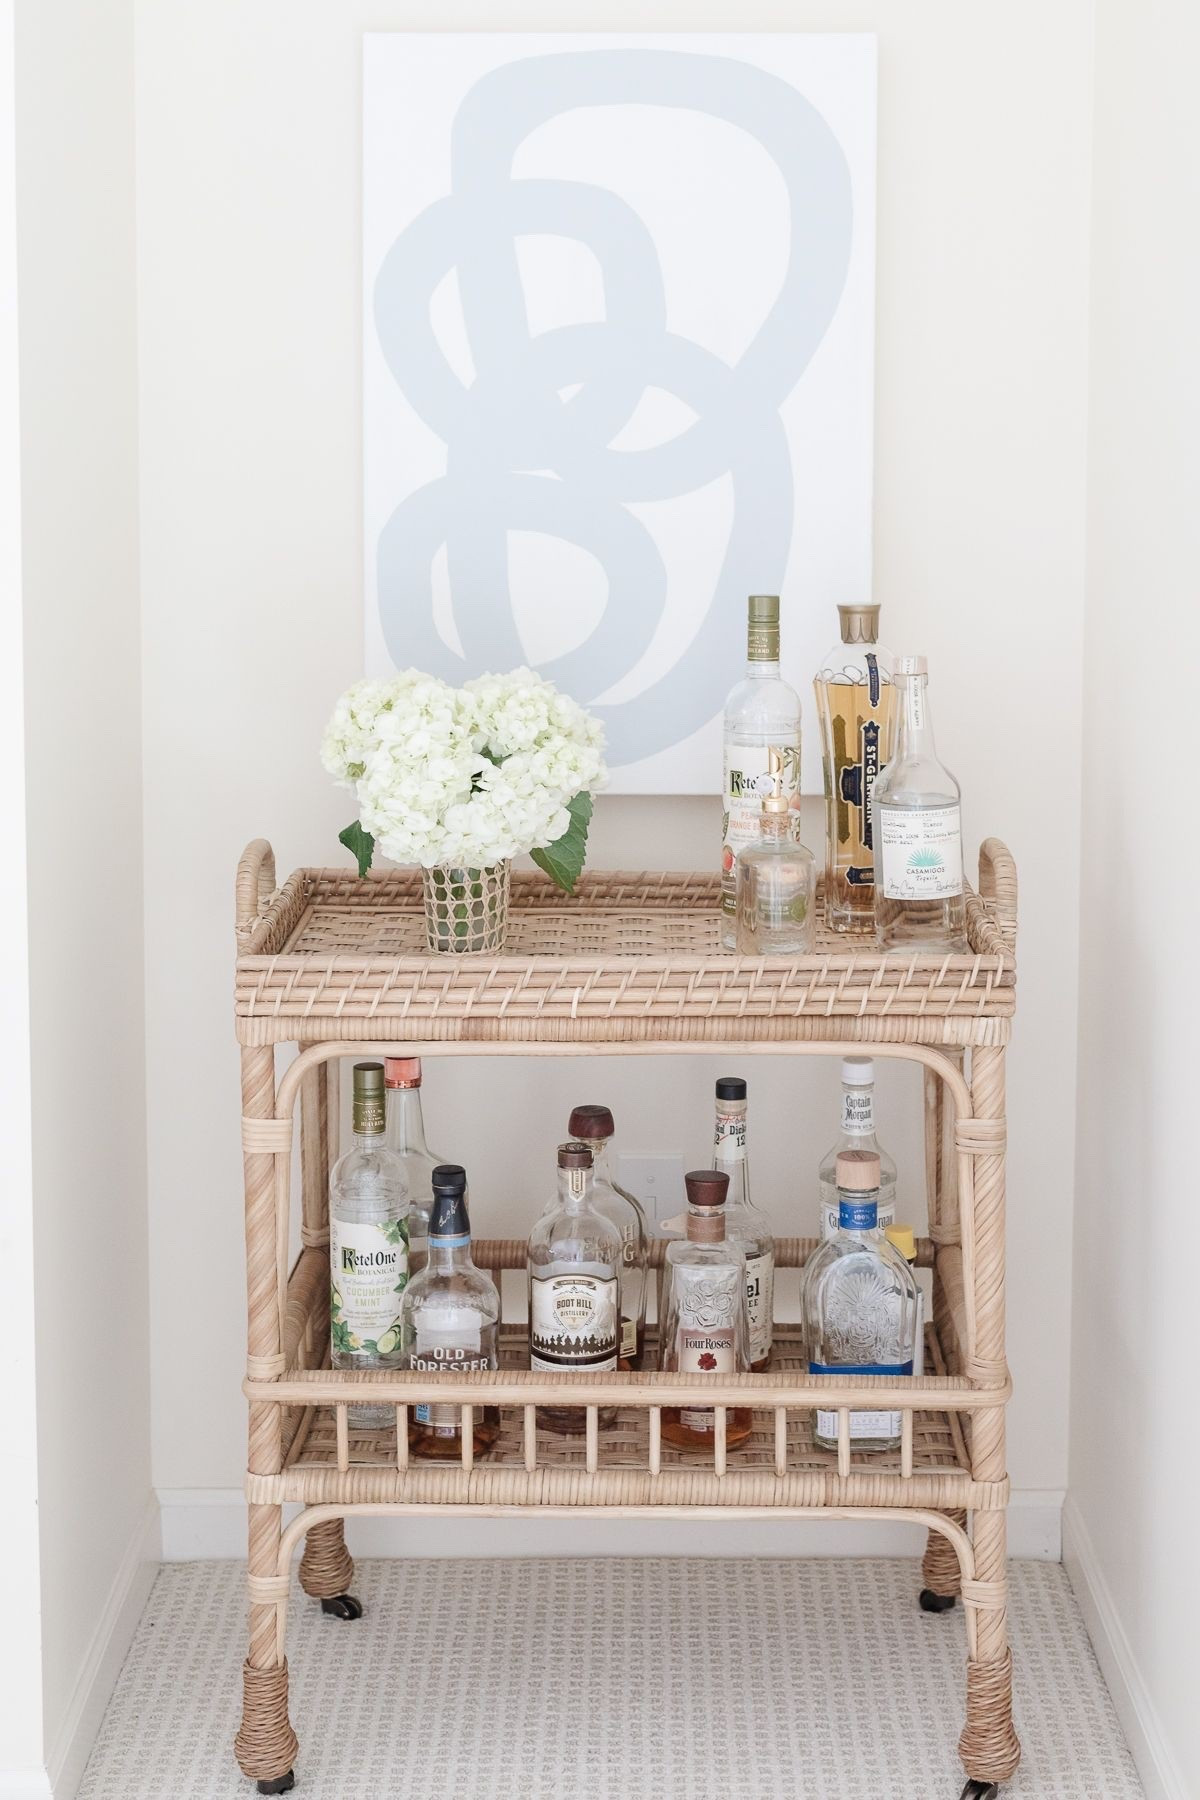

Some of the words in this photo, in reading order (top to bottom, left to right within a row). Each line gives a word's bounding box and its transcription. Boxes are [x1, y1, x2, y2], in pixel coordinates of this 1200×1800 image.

[906, 866, 945, 875] CASAMIGOS
[915, 875, 938, 884] Tequila
[845, 1095, 871, 1109] Captain
[845, 1108, 872, 1122] Morgan
[342, 1249, 374, 1273] Ketel
[375, 1251, 397, 1267] One
[357, 1267, 397, 1276] BOTANICAL
[346, 1286, 390, 1297] CUCUMBER
[556, 1298, 575, 1309] BOOT
[576, 1297, 593, 1310] HILL
[433, 1346, 465, 1360] OLD
[409, 1353, 490, 1371] FORESTER
